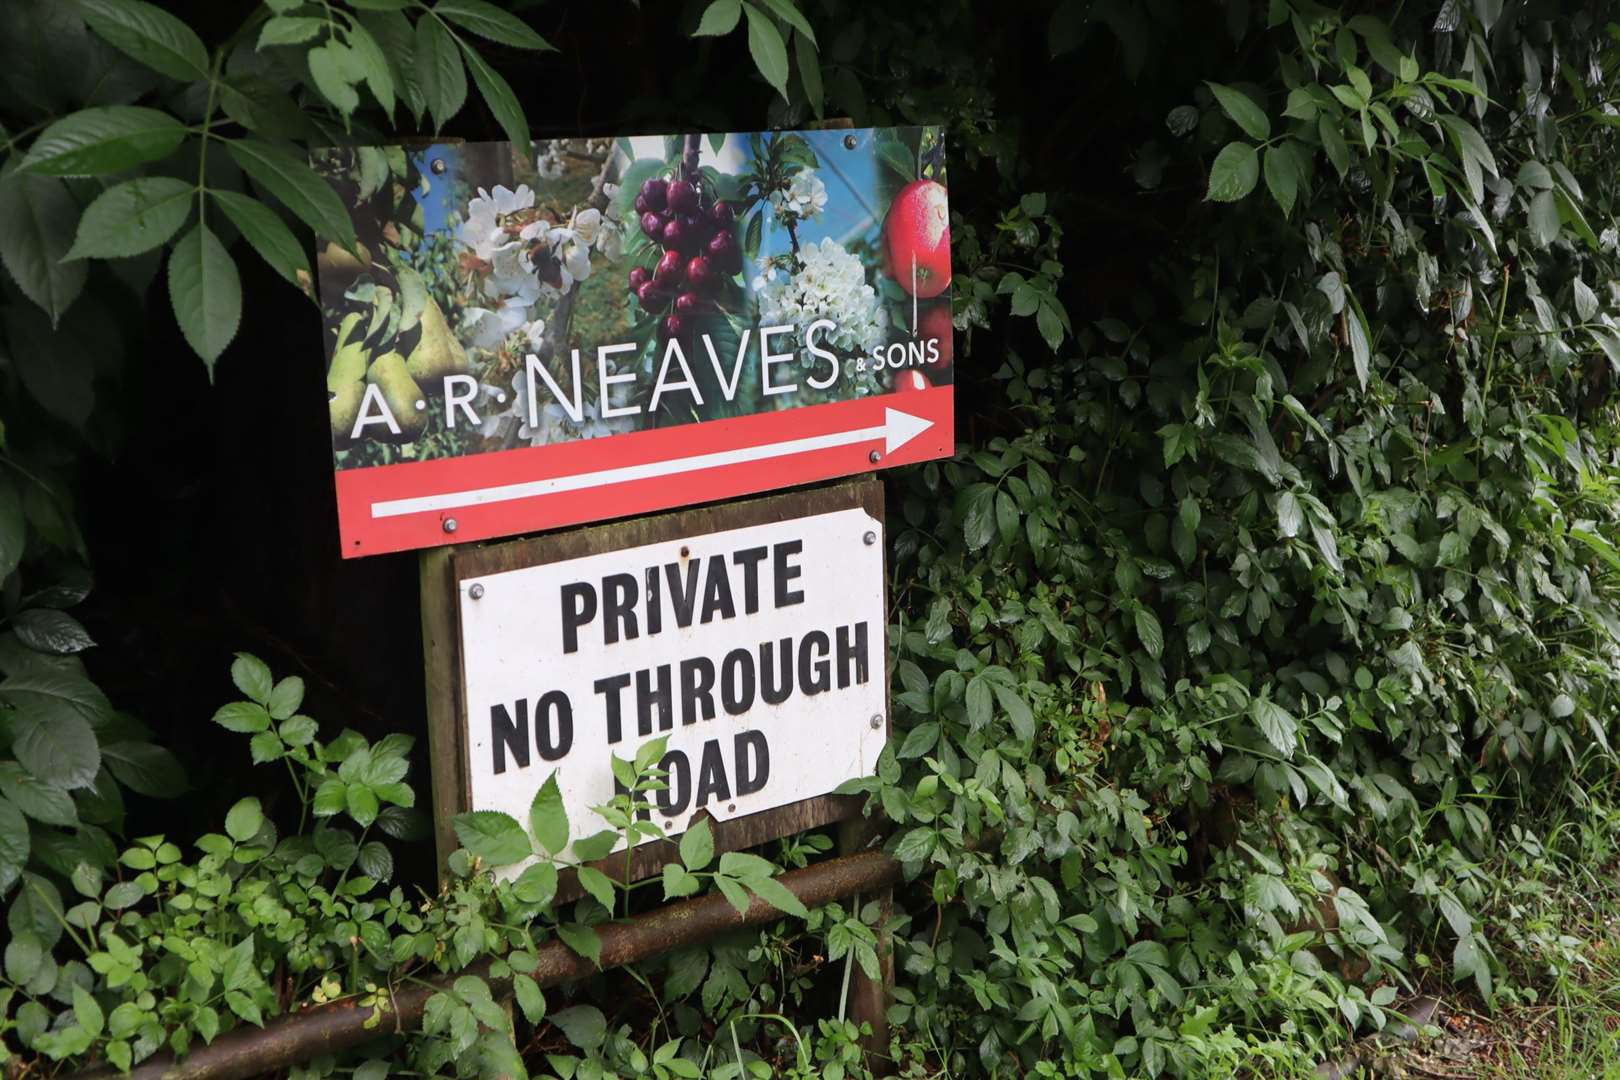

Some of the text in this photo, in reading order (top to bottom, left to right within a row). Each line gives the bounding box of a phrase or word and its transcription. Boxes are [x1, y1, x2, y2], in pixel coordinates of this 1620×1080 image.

[855, 358, 866, 372] &
[872, 338, 940, 371] SONS
[560, 539, 805, 654] PRIVATE
[490, 621, 869, 775] NO THROUGH
